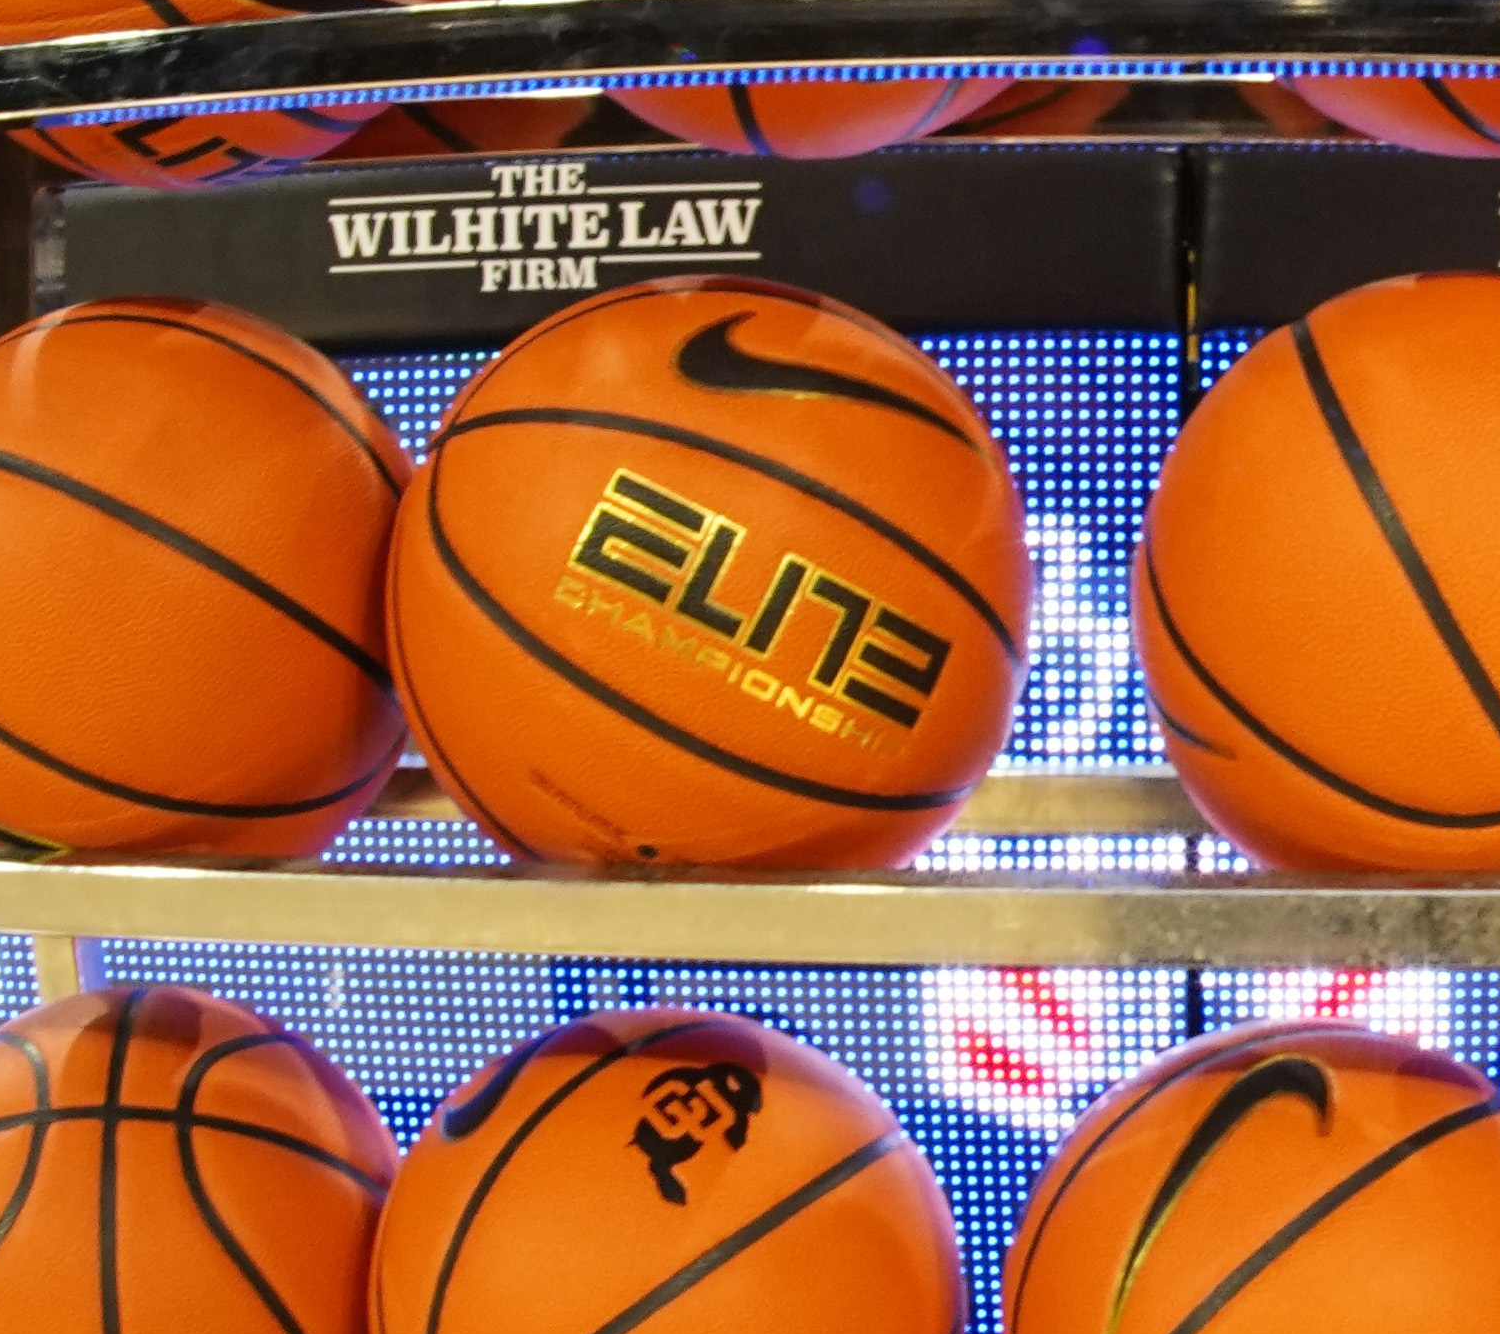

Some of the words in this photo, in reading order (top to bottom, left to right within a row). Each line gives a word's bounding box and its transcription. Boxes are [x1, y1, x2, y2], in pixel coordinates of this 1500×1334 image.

[491, 164, 586, 198] THE
[330, 202, 610, 260] WILHITE
[619, 199, 760, 247] LAW
[481, 256, 599, 293] FIRM
[569, 467, 954, 732] ELITE
